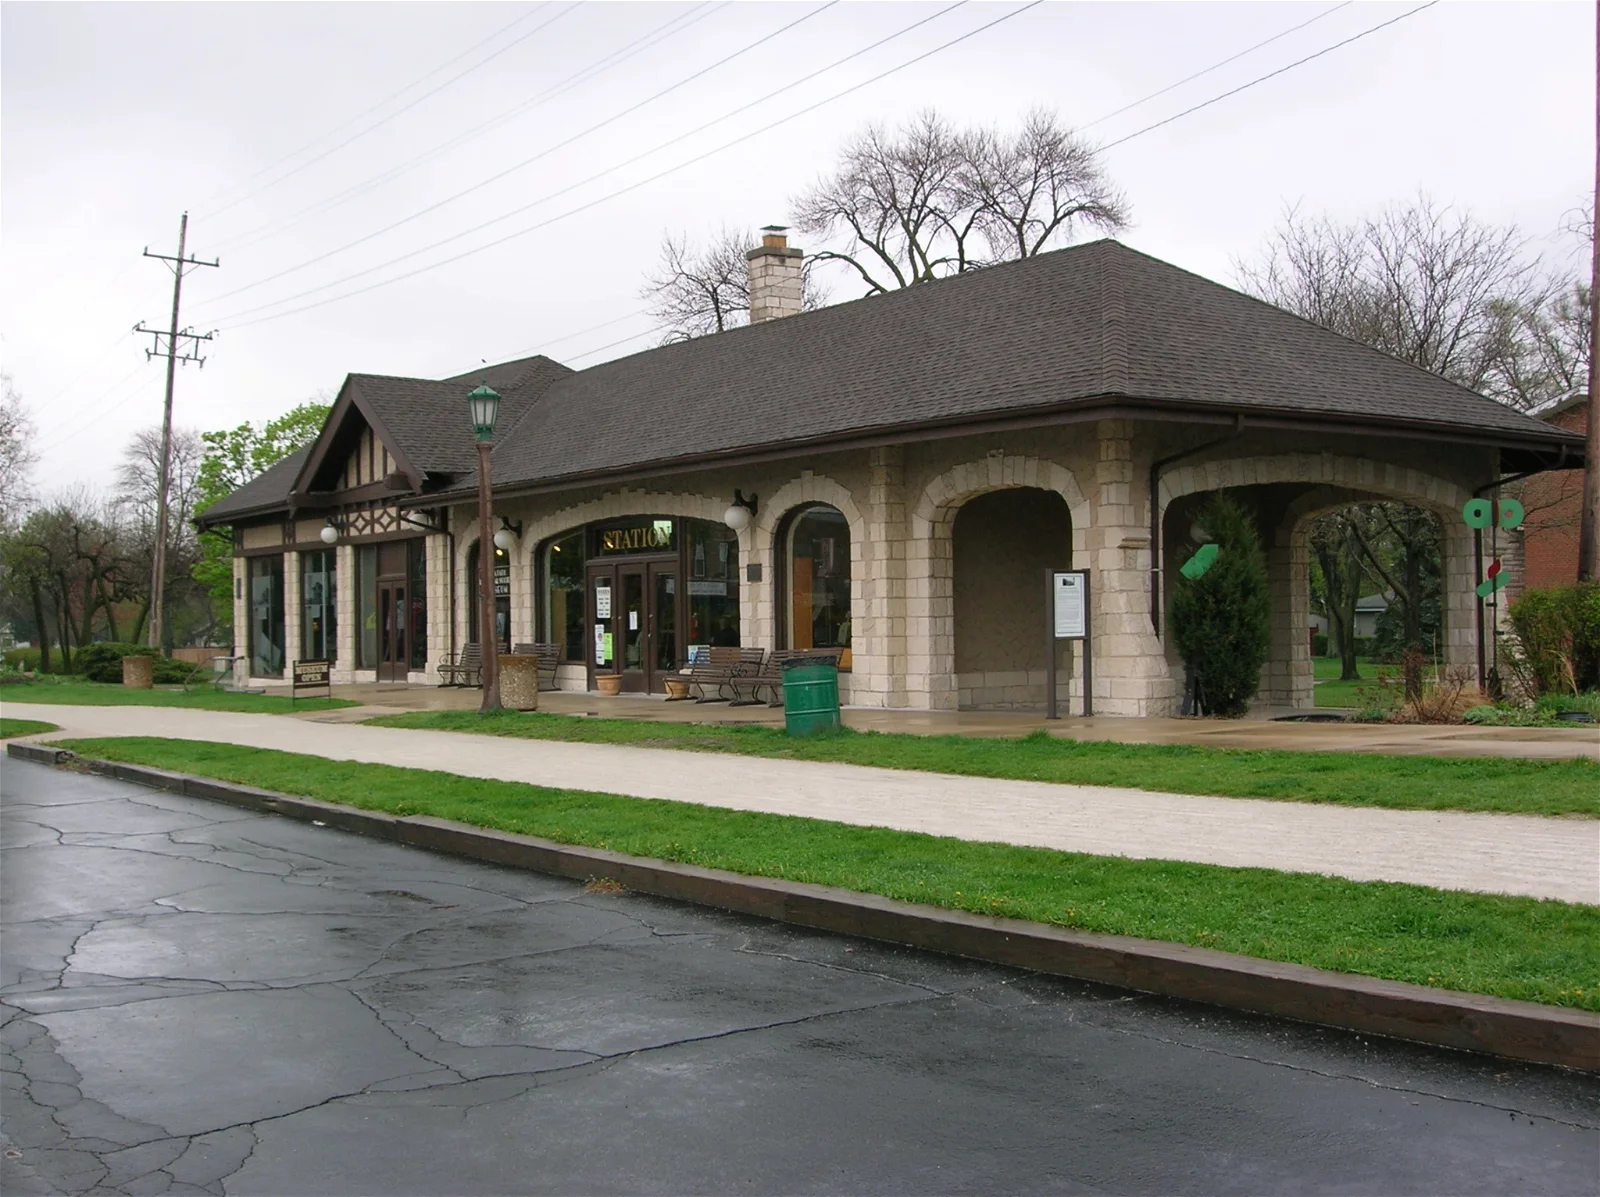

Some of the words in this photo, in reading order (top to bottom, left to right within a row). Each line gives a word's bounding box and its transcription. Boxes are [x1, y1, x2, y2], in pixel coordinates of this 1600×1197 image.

[603, 526, 670, 551] STATION
[295, 665, 328, 675] MUSEUM
[301, 673, 322, 682] OPEN
